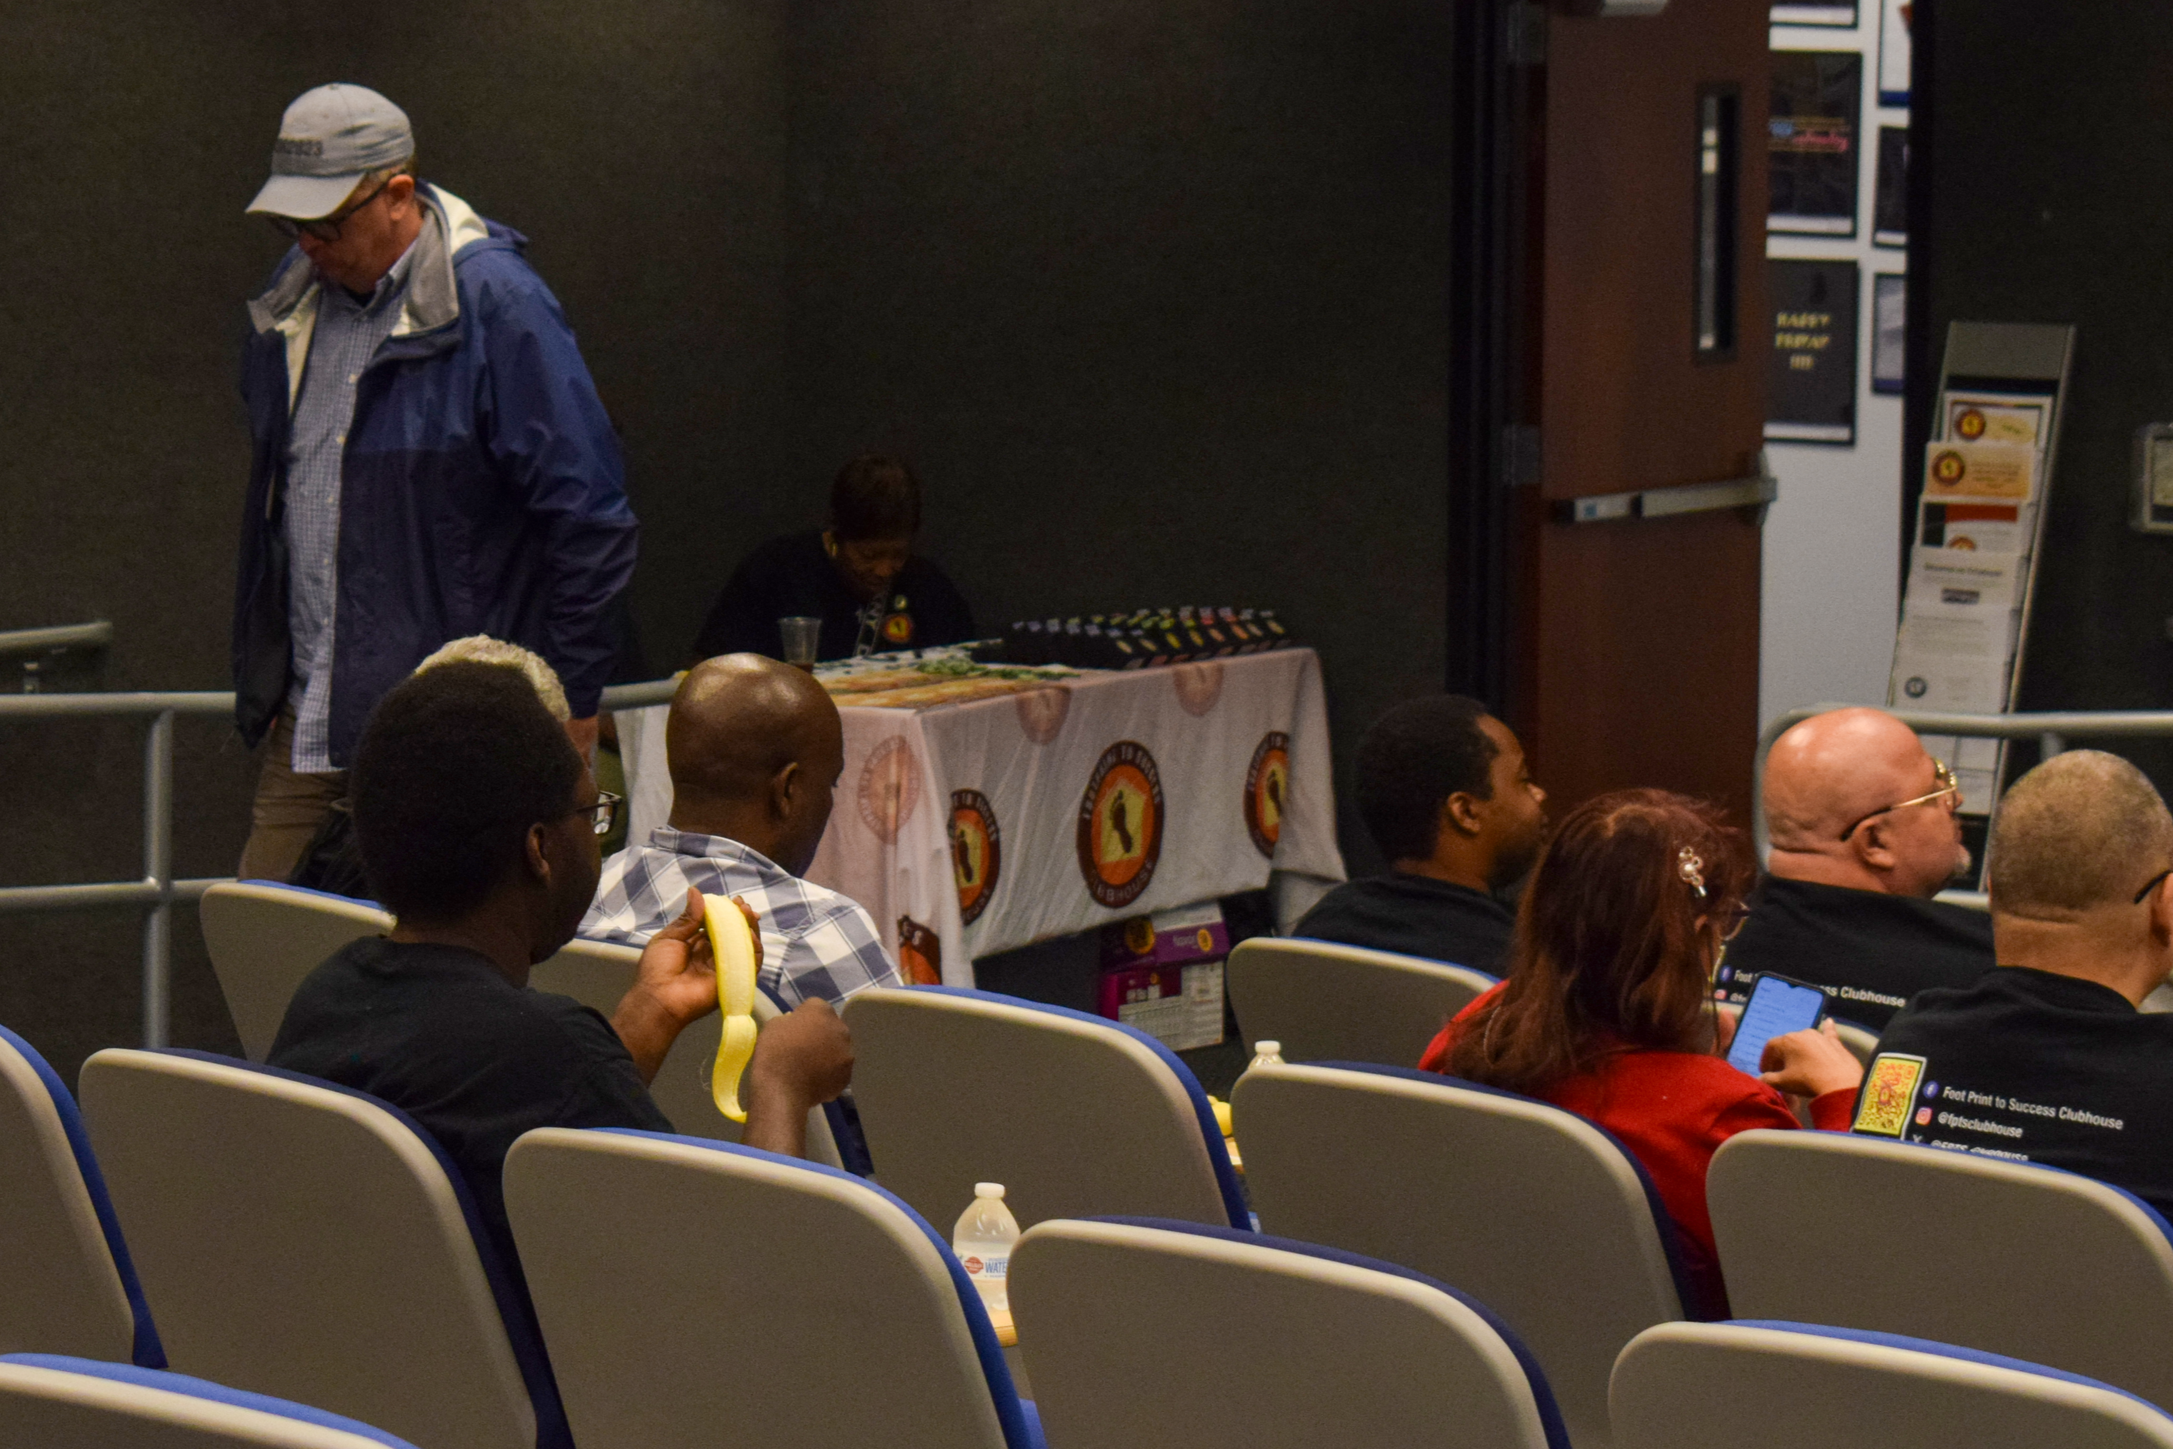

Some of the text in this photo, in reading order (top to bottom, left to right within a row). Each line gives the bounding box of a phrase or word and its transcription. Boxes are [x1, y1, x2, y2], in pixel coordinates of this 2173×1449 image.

[1840, 986, 1905, 1008] Clubhouse
[1943, 1086, 2124, 1130] Foot Print to Success Clubhouse
[1938, 1111, 2024, 1139] @fptsclubhouse
[985, 1262, 1007, 1273] WATE
